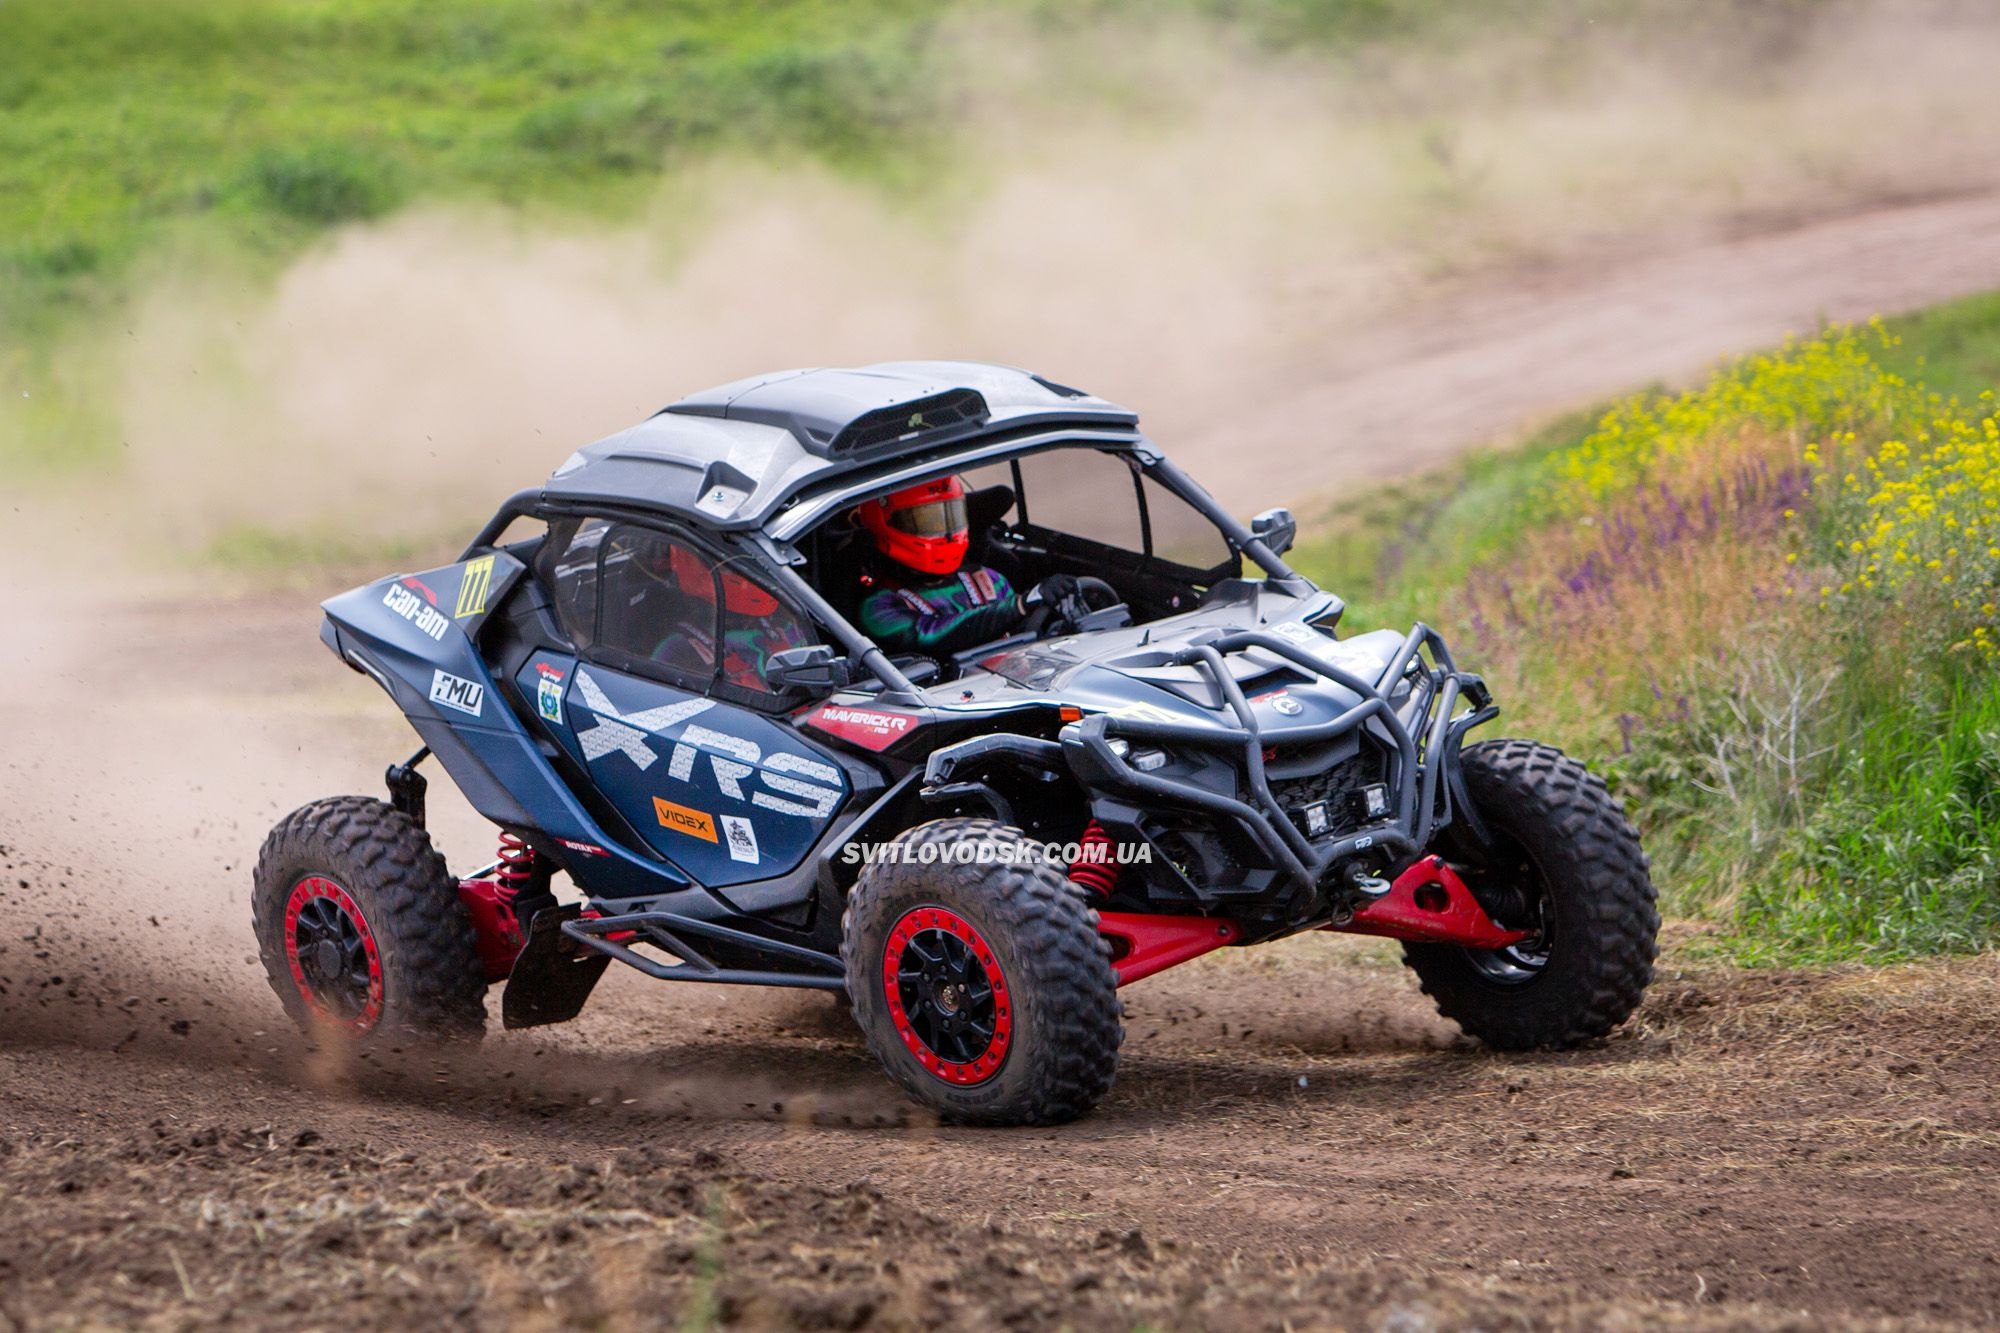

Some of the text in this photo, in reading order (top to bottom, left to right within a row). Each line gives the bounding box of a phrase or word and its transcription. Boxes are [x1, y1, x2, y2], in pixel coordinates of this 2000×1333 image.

[383, 583, 450, 641] can-am
[823, 709, 907, 731] MAVERICK R
[576, 668, 842, 818] XRS
[659, 807, 708, 832] VIDEX
